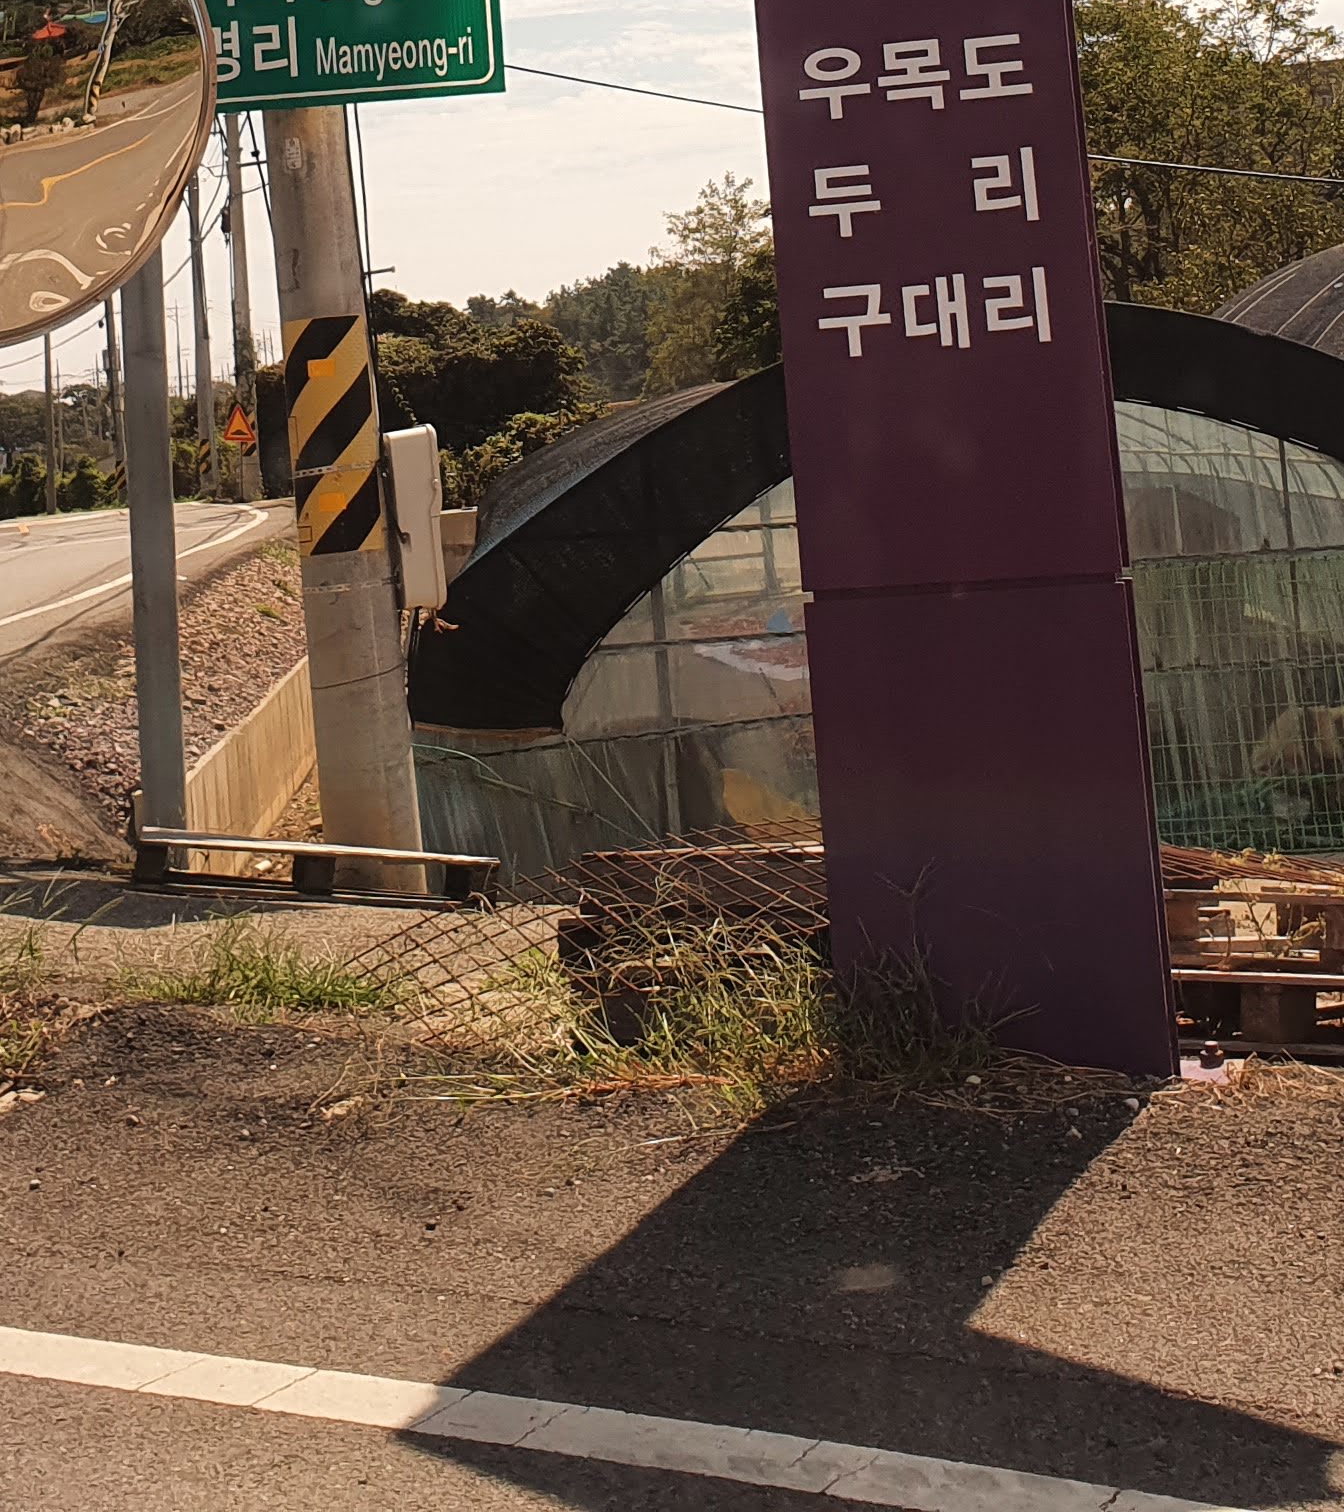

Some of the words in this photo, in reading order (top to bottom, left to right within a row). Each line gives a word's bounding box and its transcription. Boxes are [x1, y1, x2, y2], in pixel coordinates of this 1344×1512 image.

[211, 15, 298, 83] 명리
[315, 27, 474, 81] Mamyeong-ri
[798, 32, 1034, 121] 우목도
[817, 266, 1053, 358] 구대리
